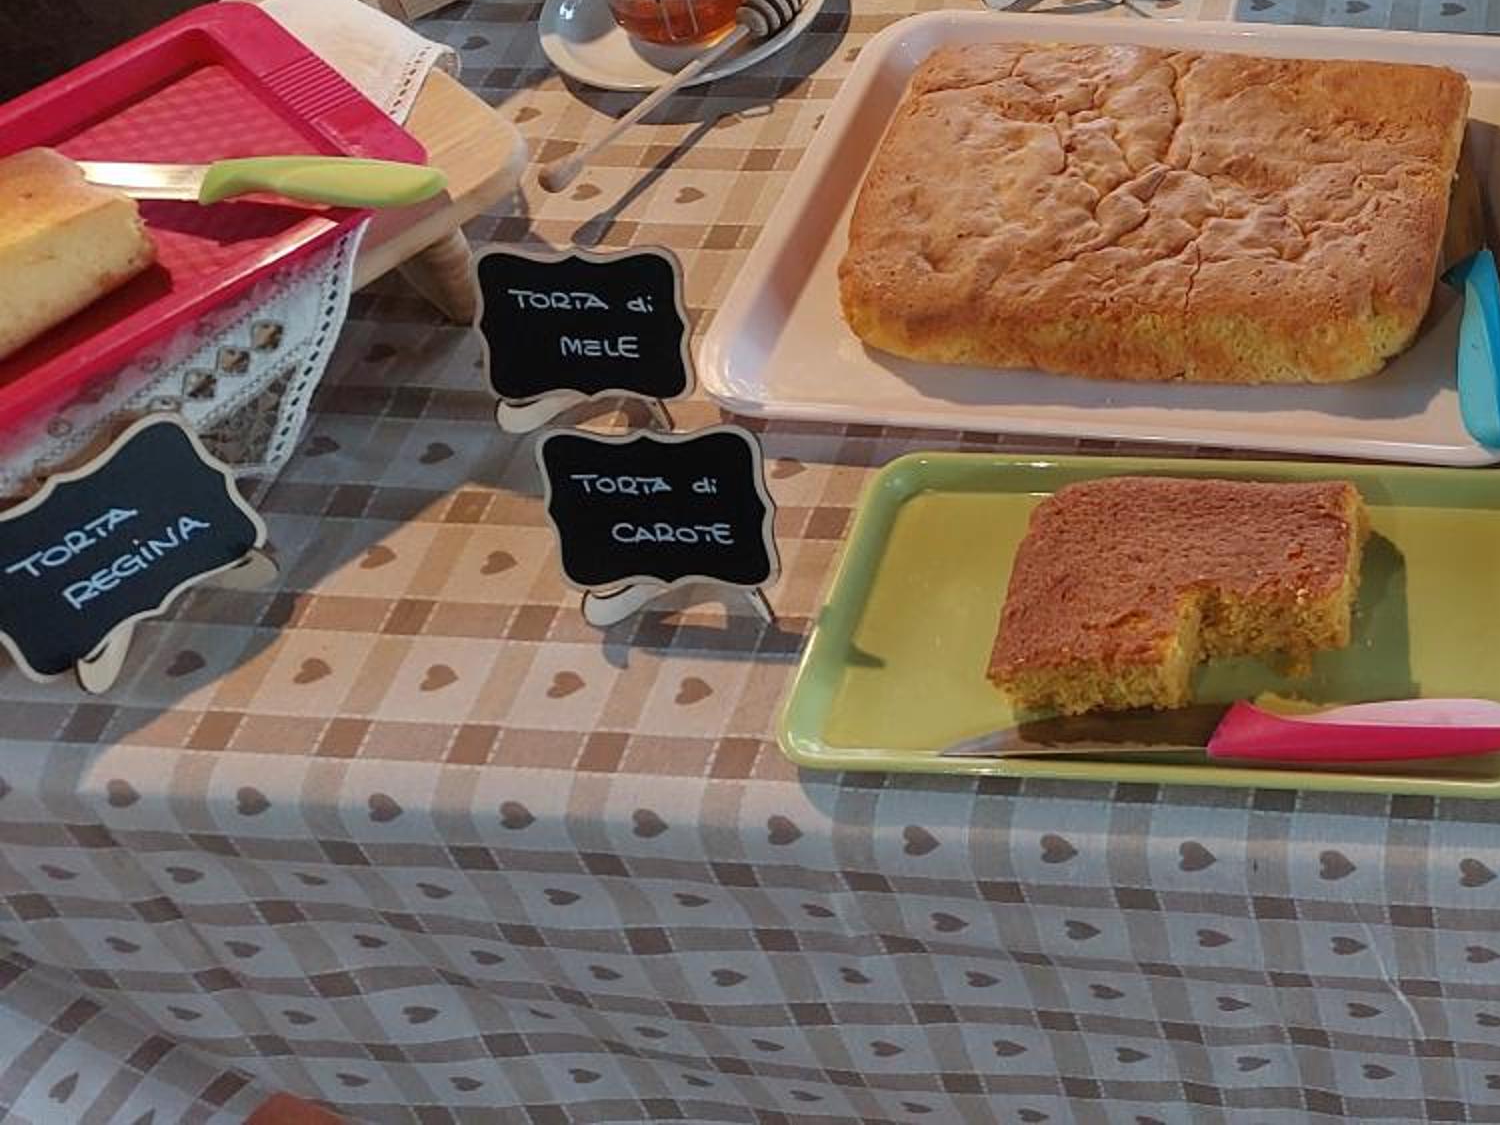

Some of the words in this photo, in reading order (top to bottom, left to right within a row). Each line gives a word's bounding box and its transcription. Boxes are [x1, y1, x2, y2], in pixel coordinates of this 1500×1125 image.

[507, 288, 609, 310] TORTA
[626, 296, 654, 313] di
[560, 335, 641, 359] MELE
[570, 474, 672, 495] TORTA
[692, 476, 718, 494] di
[4, 507, 139, 577] TORTA
[611, 522, 735, 545] CAROTE
